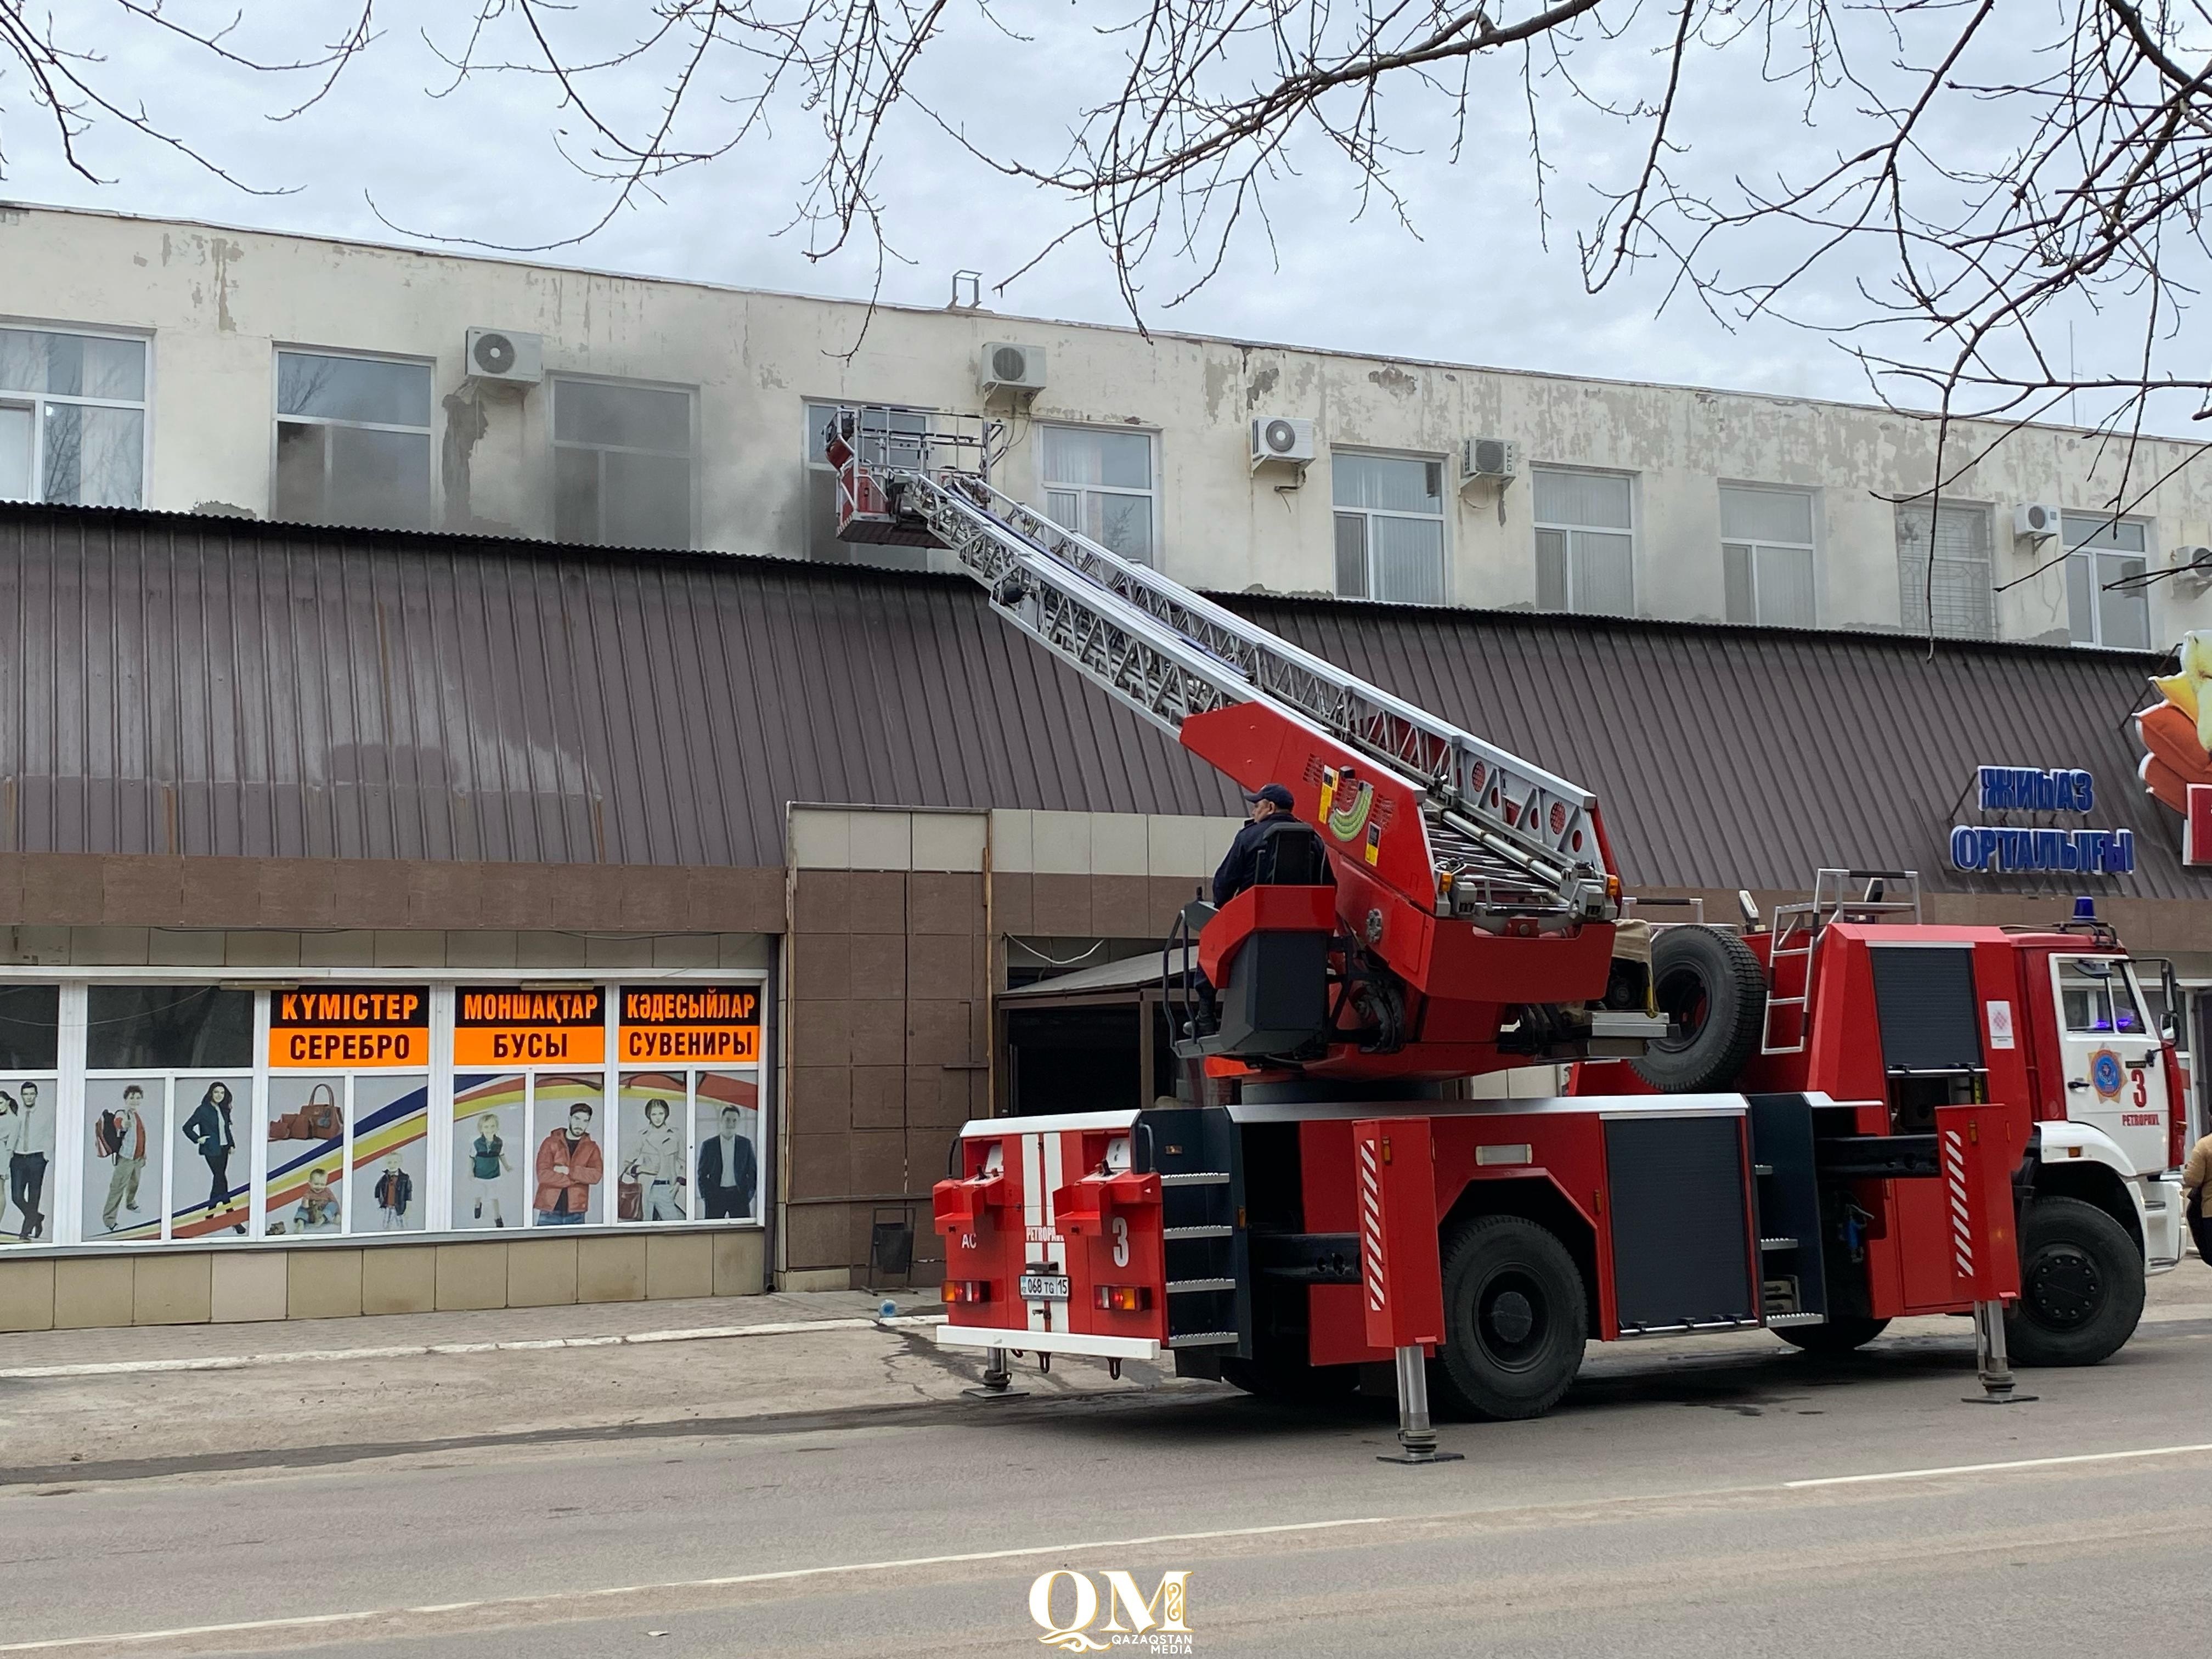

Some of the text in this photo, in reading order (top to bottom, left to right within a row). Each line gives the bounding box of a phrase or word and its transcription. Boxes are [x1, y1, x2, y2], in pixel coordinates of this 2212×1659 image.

[282, 994, 419, 1020] КҮМІСТЕР
[464, 994, 598, 1024] МОНШАҚТАР
[627, 989, 755, 1022] КӘДЕСЫЙЛАР
[290, 1034, 410, 1060] СЕРЕБРО
[493, 1032, 568, 1058] БУСЫ
[629, 1031, 752, 1057] СУВЕНИРЫ
[2131, 1068, 2147, 1108] 3
[1113, 1217, 1130, 1267] 3
[1058, 1279, 1067, 1294] 15
